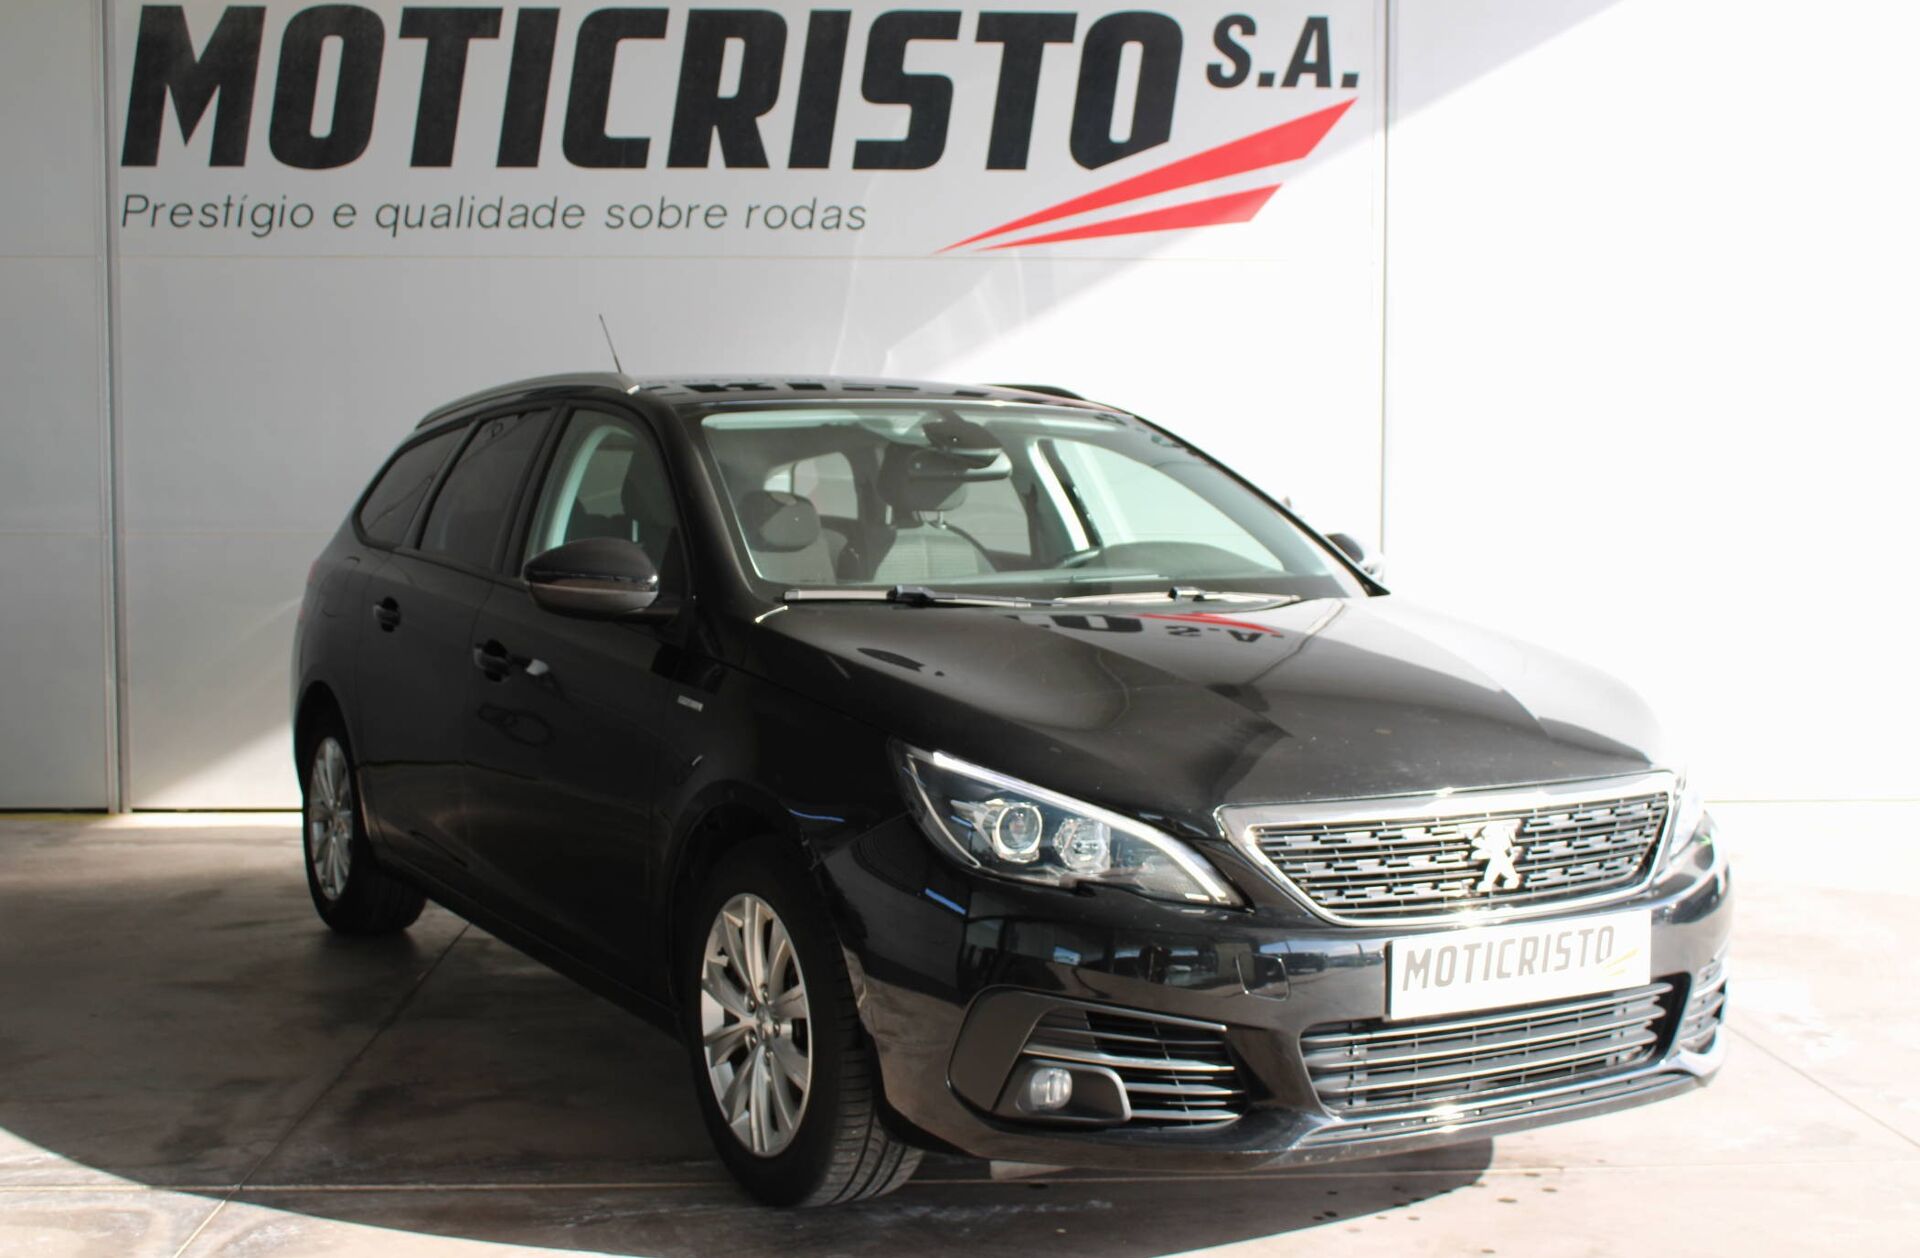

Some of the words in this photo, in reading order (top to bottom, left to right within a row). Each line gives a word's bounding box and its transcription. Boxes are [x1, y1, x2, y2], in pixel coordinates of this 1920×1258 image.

[121, 5, 1183, 170] MOTICRISTO
[1206, 14, 1359, 88] S.A.
[122, 193, 314, 238] Prestígio
[332, 203, 356, 229] e
[375, 195, 585, 238] qualidade
[604, 195, 728, 230] sobre
[745, 195, 866, 231] rodas
[1402, 925, 1615, 992] MOTICRISTO
